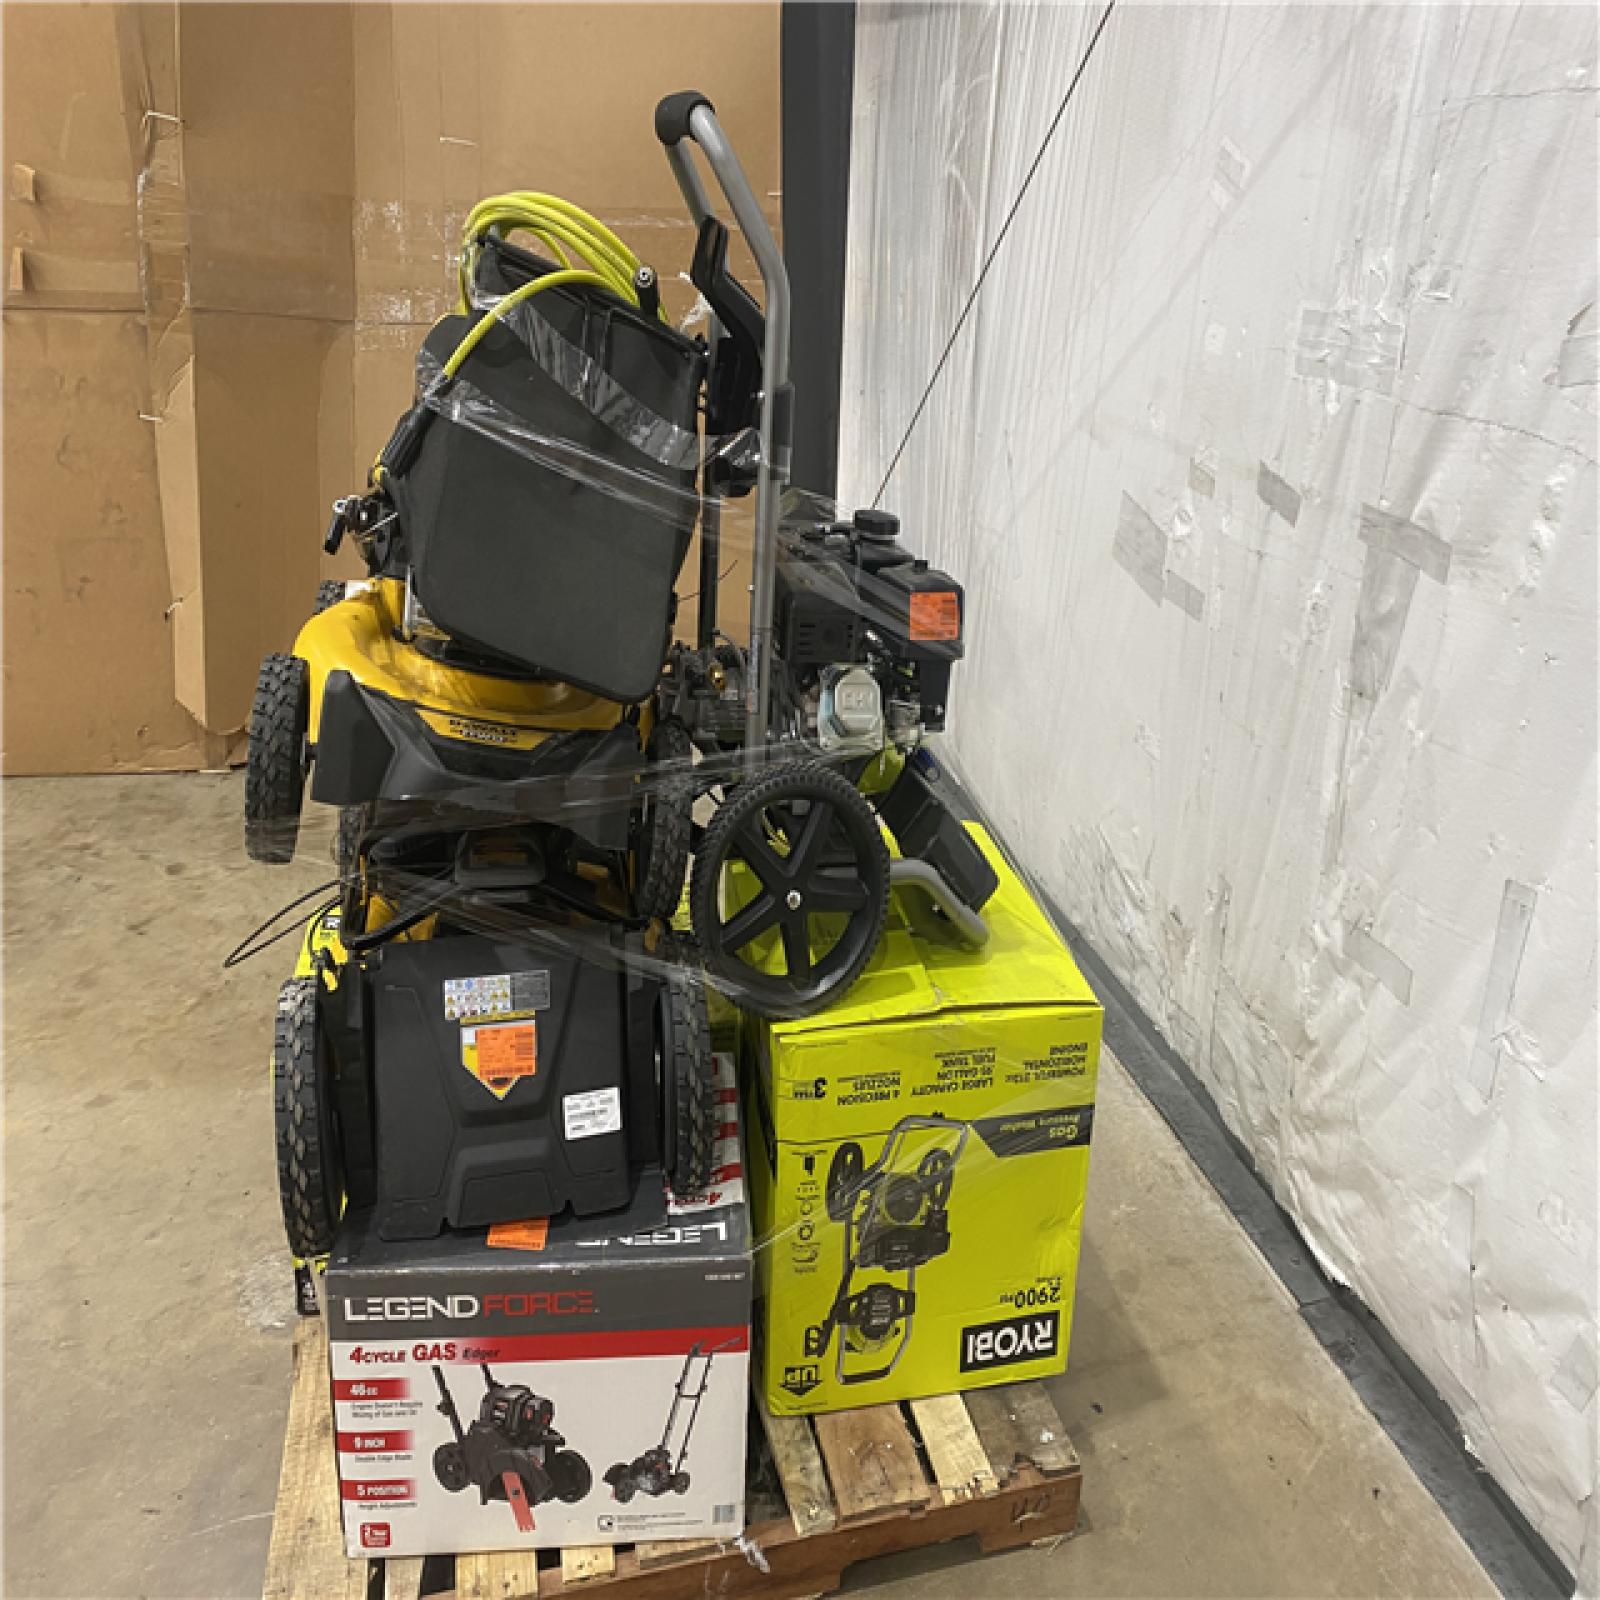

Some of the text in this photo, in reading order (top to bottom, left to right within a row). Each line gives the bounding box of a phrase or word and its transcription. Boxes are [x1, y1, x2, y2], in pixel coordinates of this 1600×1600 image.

[815, 1077, 828, 1098] 3
[911, 1077, 993, 1096] LARGE CAPACITY
[1049, 1124, 1078, 1141] Gas
[966, 1319, 1054, 1364] RYOBI
[411, 1342, 457, 1361] GAS
